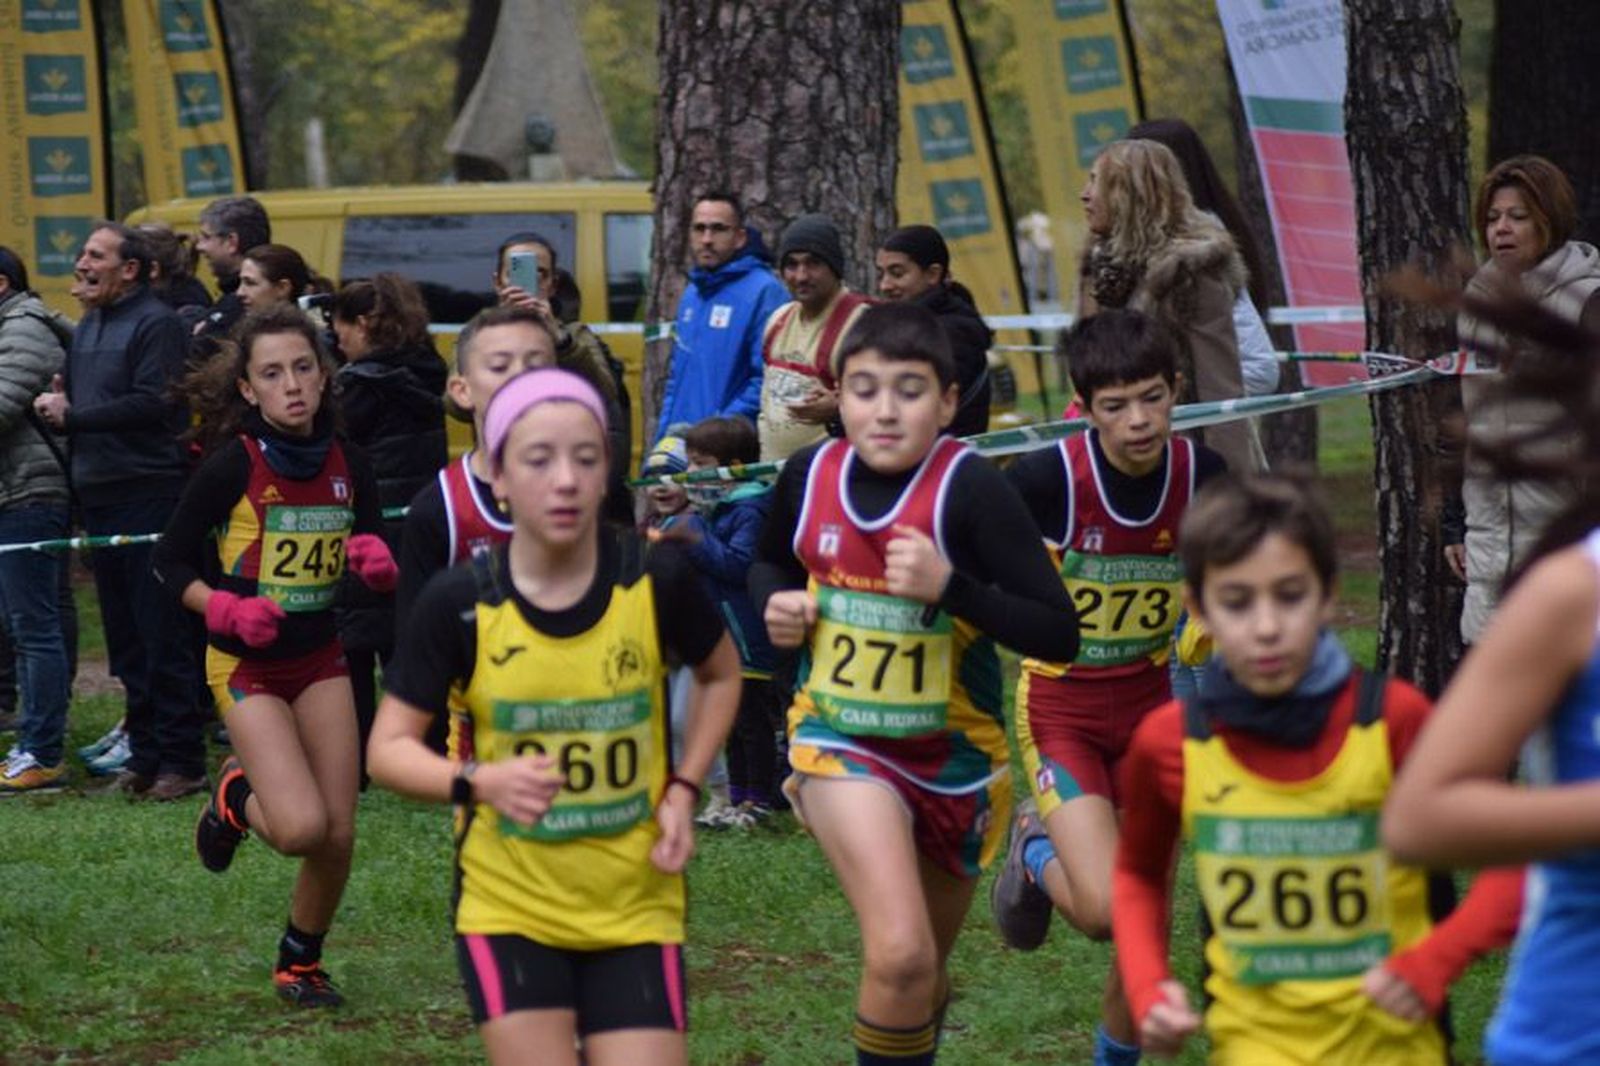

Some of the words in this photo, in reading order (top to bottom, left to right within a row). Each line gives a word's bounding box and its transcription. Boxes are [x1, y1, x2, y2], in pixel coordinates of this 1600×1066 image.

[273, 538, 343, 578] 243
[1074, 588, 1171, 631] 273
[830, 634, 926, 694] 271
[1219, 866, 1368, 931] 266
